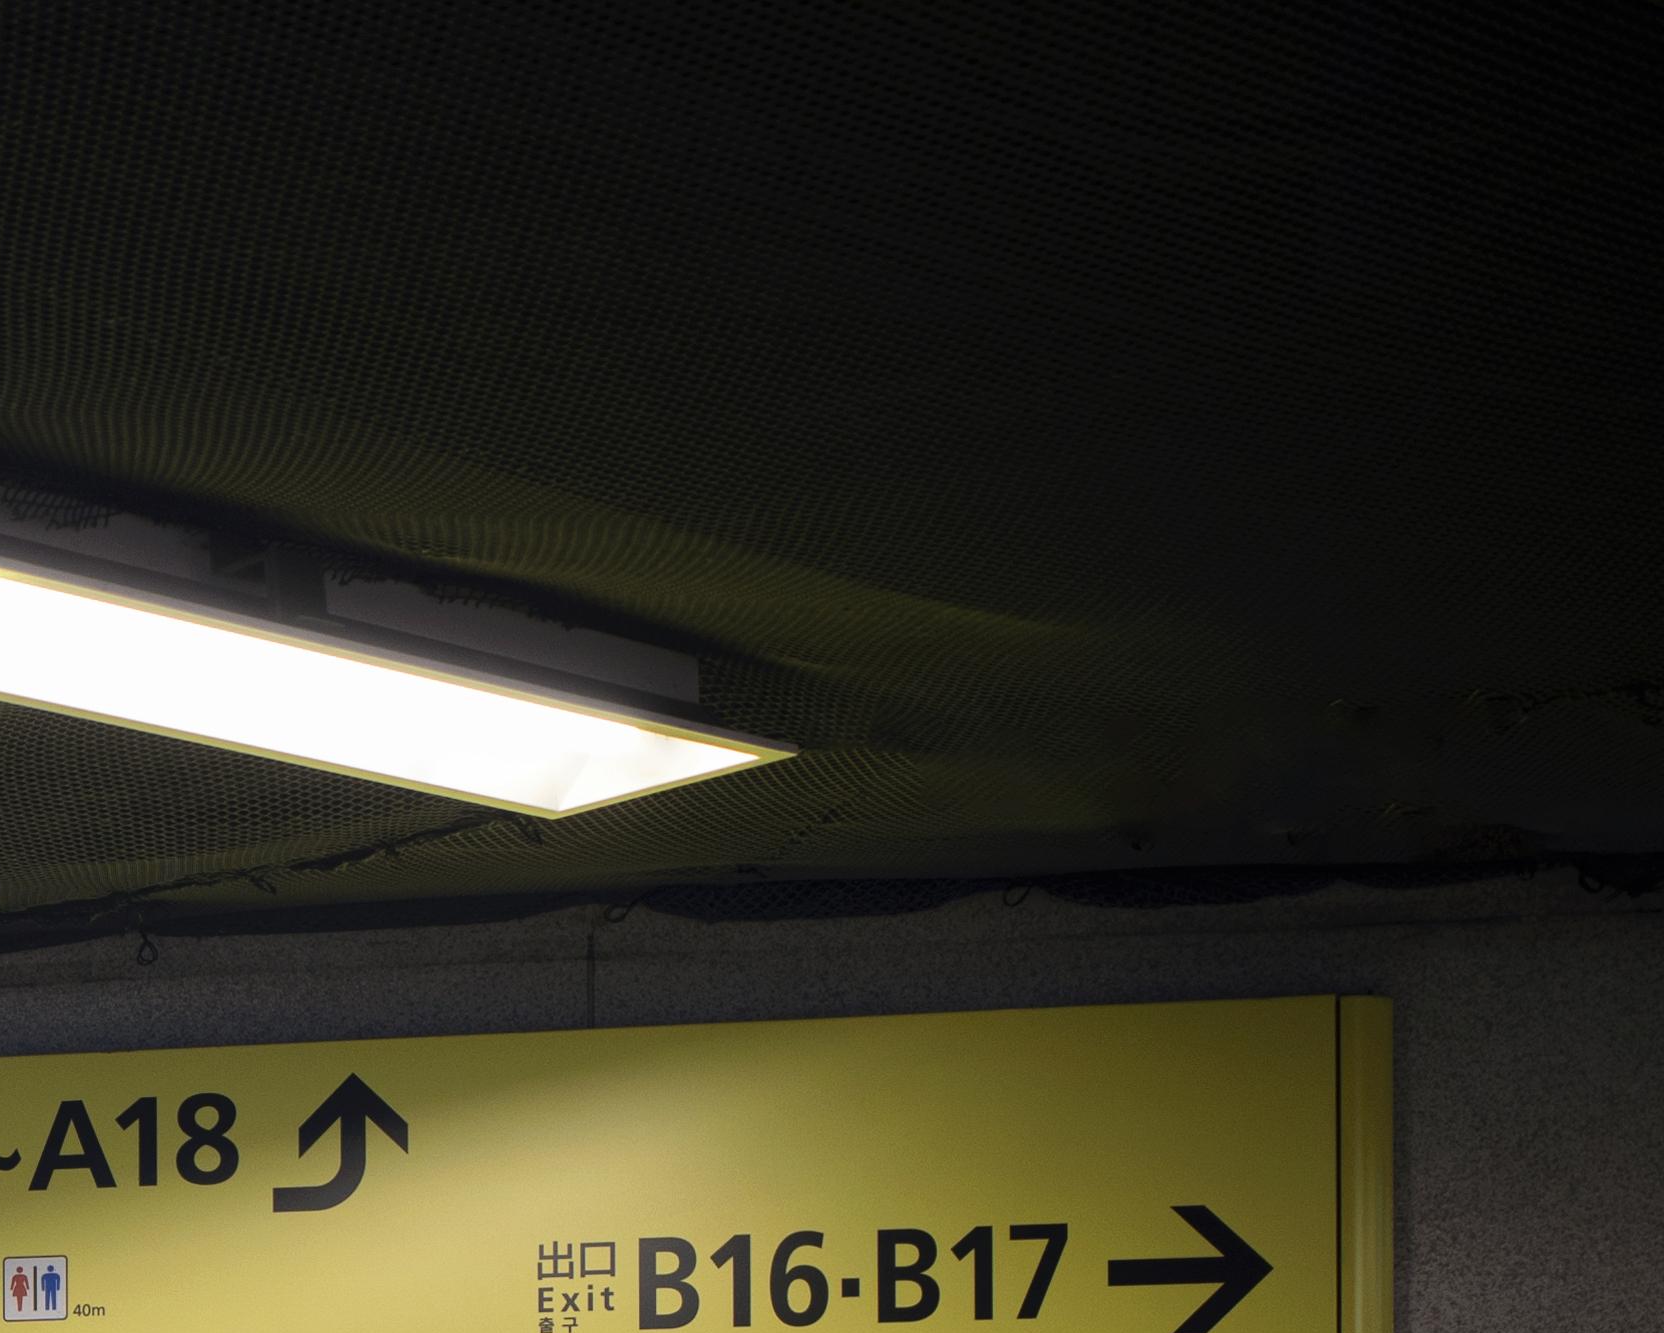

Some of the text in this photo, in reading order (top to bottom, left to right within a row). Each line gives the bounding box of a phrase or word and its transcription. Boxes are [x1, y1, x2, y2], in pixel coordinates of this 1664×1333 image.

[538, 1241, 615, 1280] 出口
[73, 1304, 105, 1316] 40m
[538, 1285, 614, 1312] Exit
